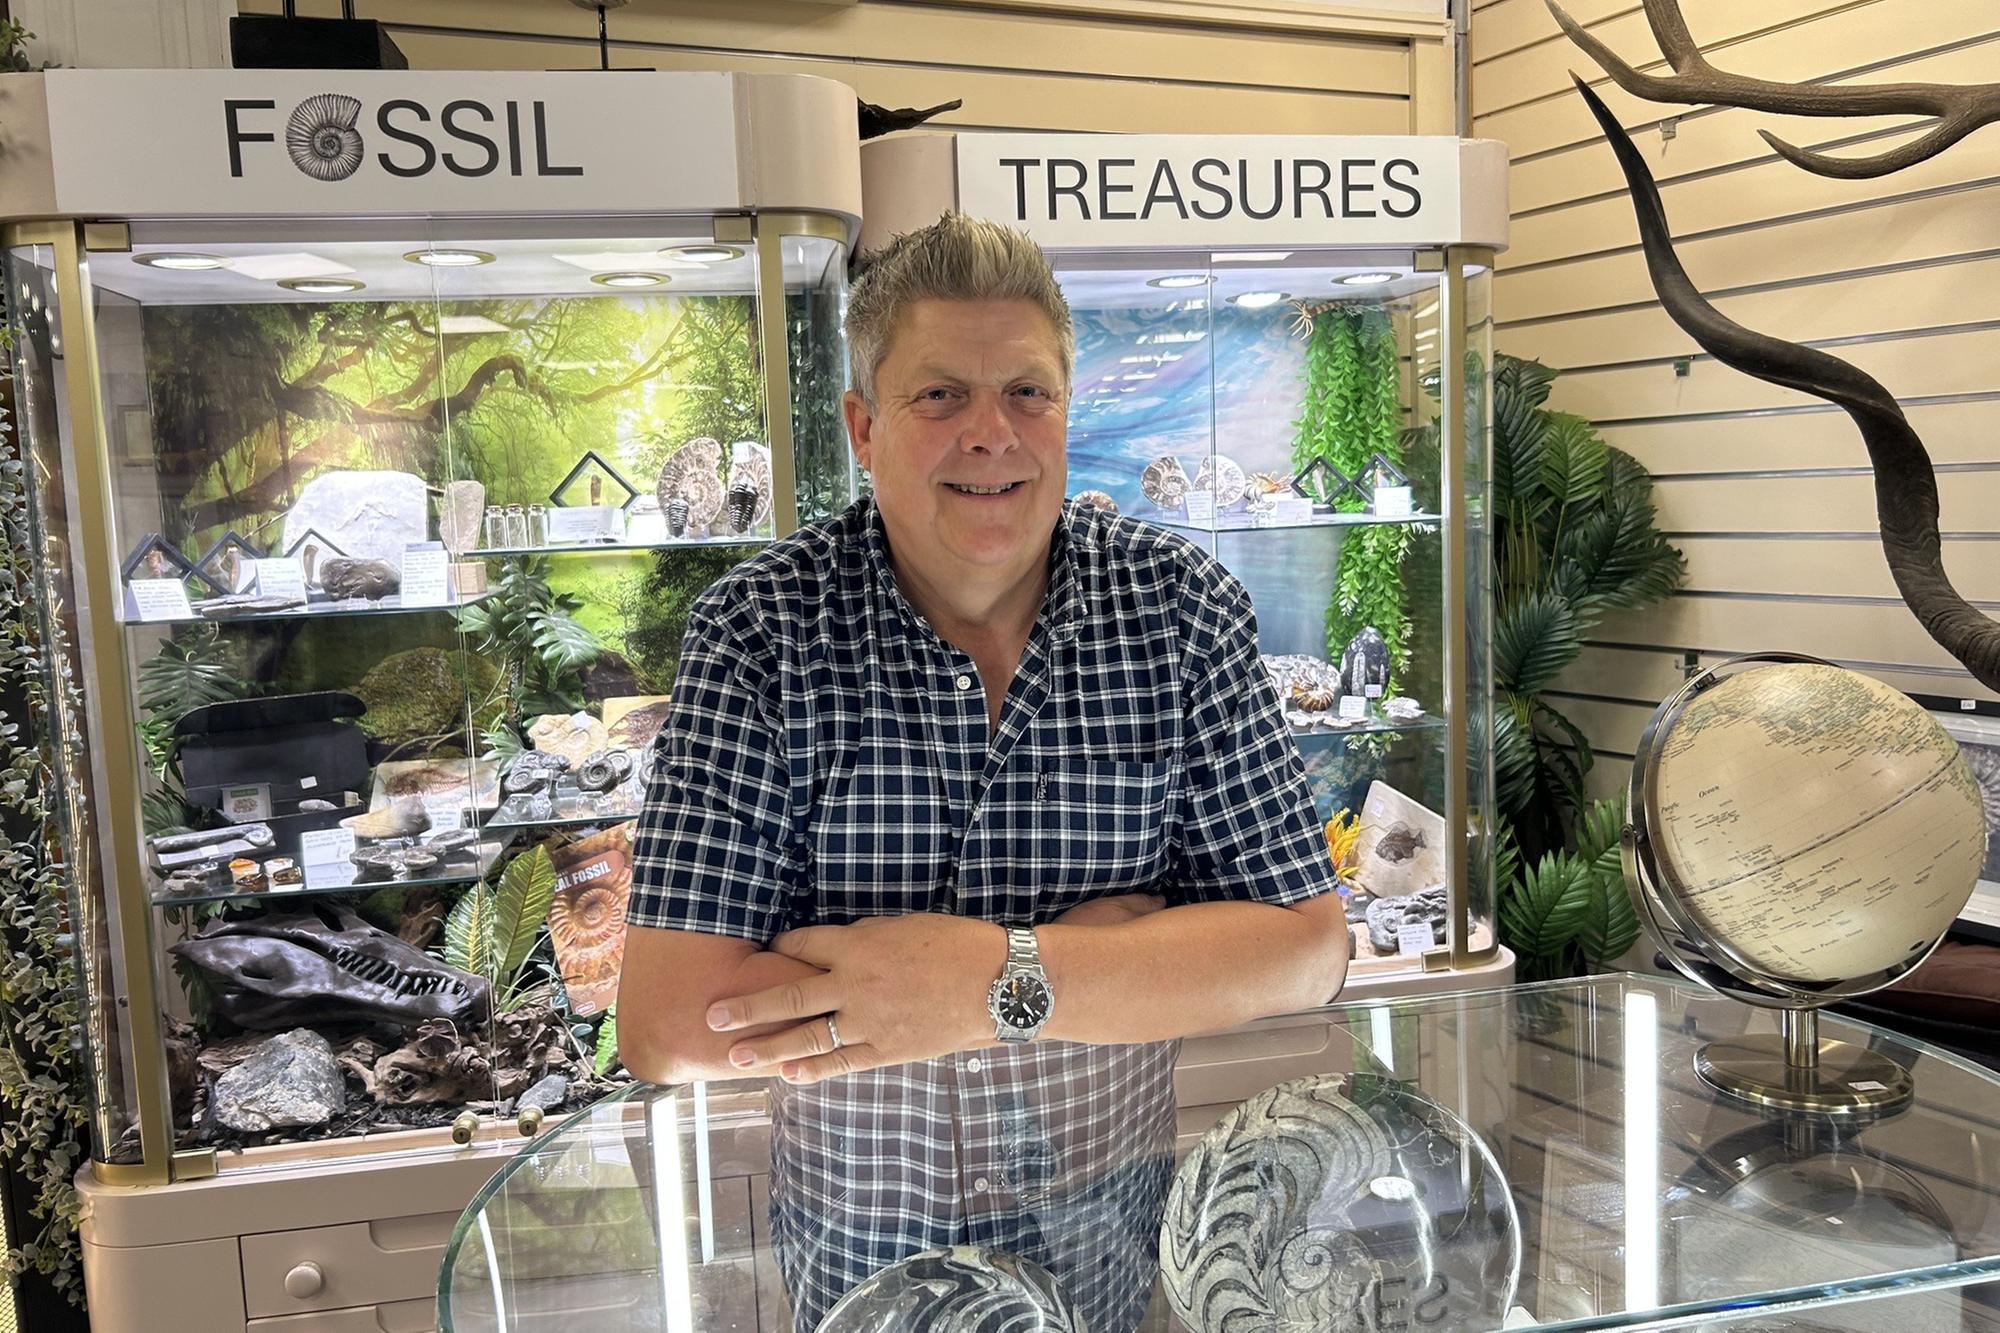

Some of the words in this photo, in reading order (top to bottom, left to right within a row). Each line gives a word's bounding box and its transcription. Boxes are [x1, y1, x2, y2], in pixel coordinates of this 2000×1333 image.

[223, 93, 584, 182] FOSSIL
[999, 158, 1422, 220] TREASURES
[554, 875, 572, 893] EAL
[572, 861, 611, 885] FOSSIL
